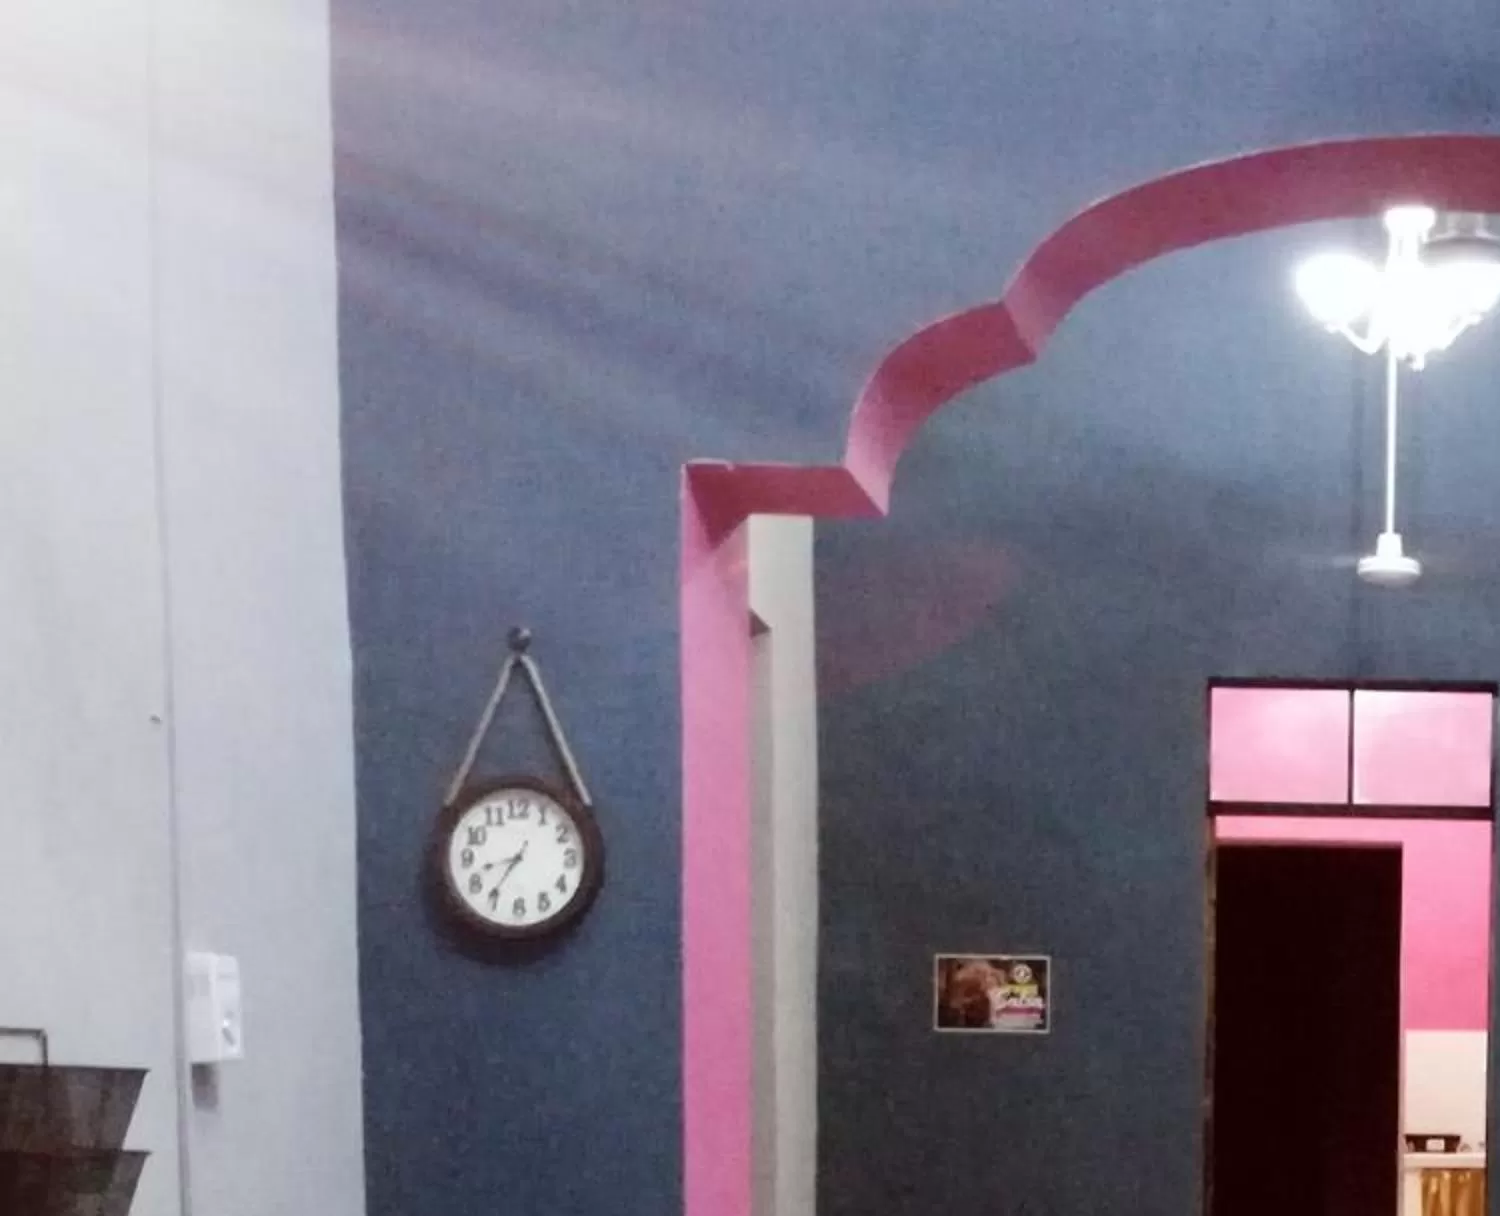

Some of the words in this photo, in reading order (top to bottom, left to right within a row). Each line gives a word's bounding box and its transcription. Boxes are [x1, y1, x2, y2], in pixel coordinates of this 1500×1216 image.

[485, 806, 504, 826] 11
[508, 799, 529, 820] 12
[538, 808, 547, 825] 1
[468, 826, 486, 845] 10
[556, 824, 568, 844] 2
[461, 848, 474, 868] 9
[564, 849, 577, 869] 3
[468, 873, 482, 894] 8
[555, 873, 566, 893] 4
[512, 897, 526, 917] 6
[537, 891, 550, 912] 5
